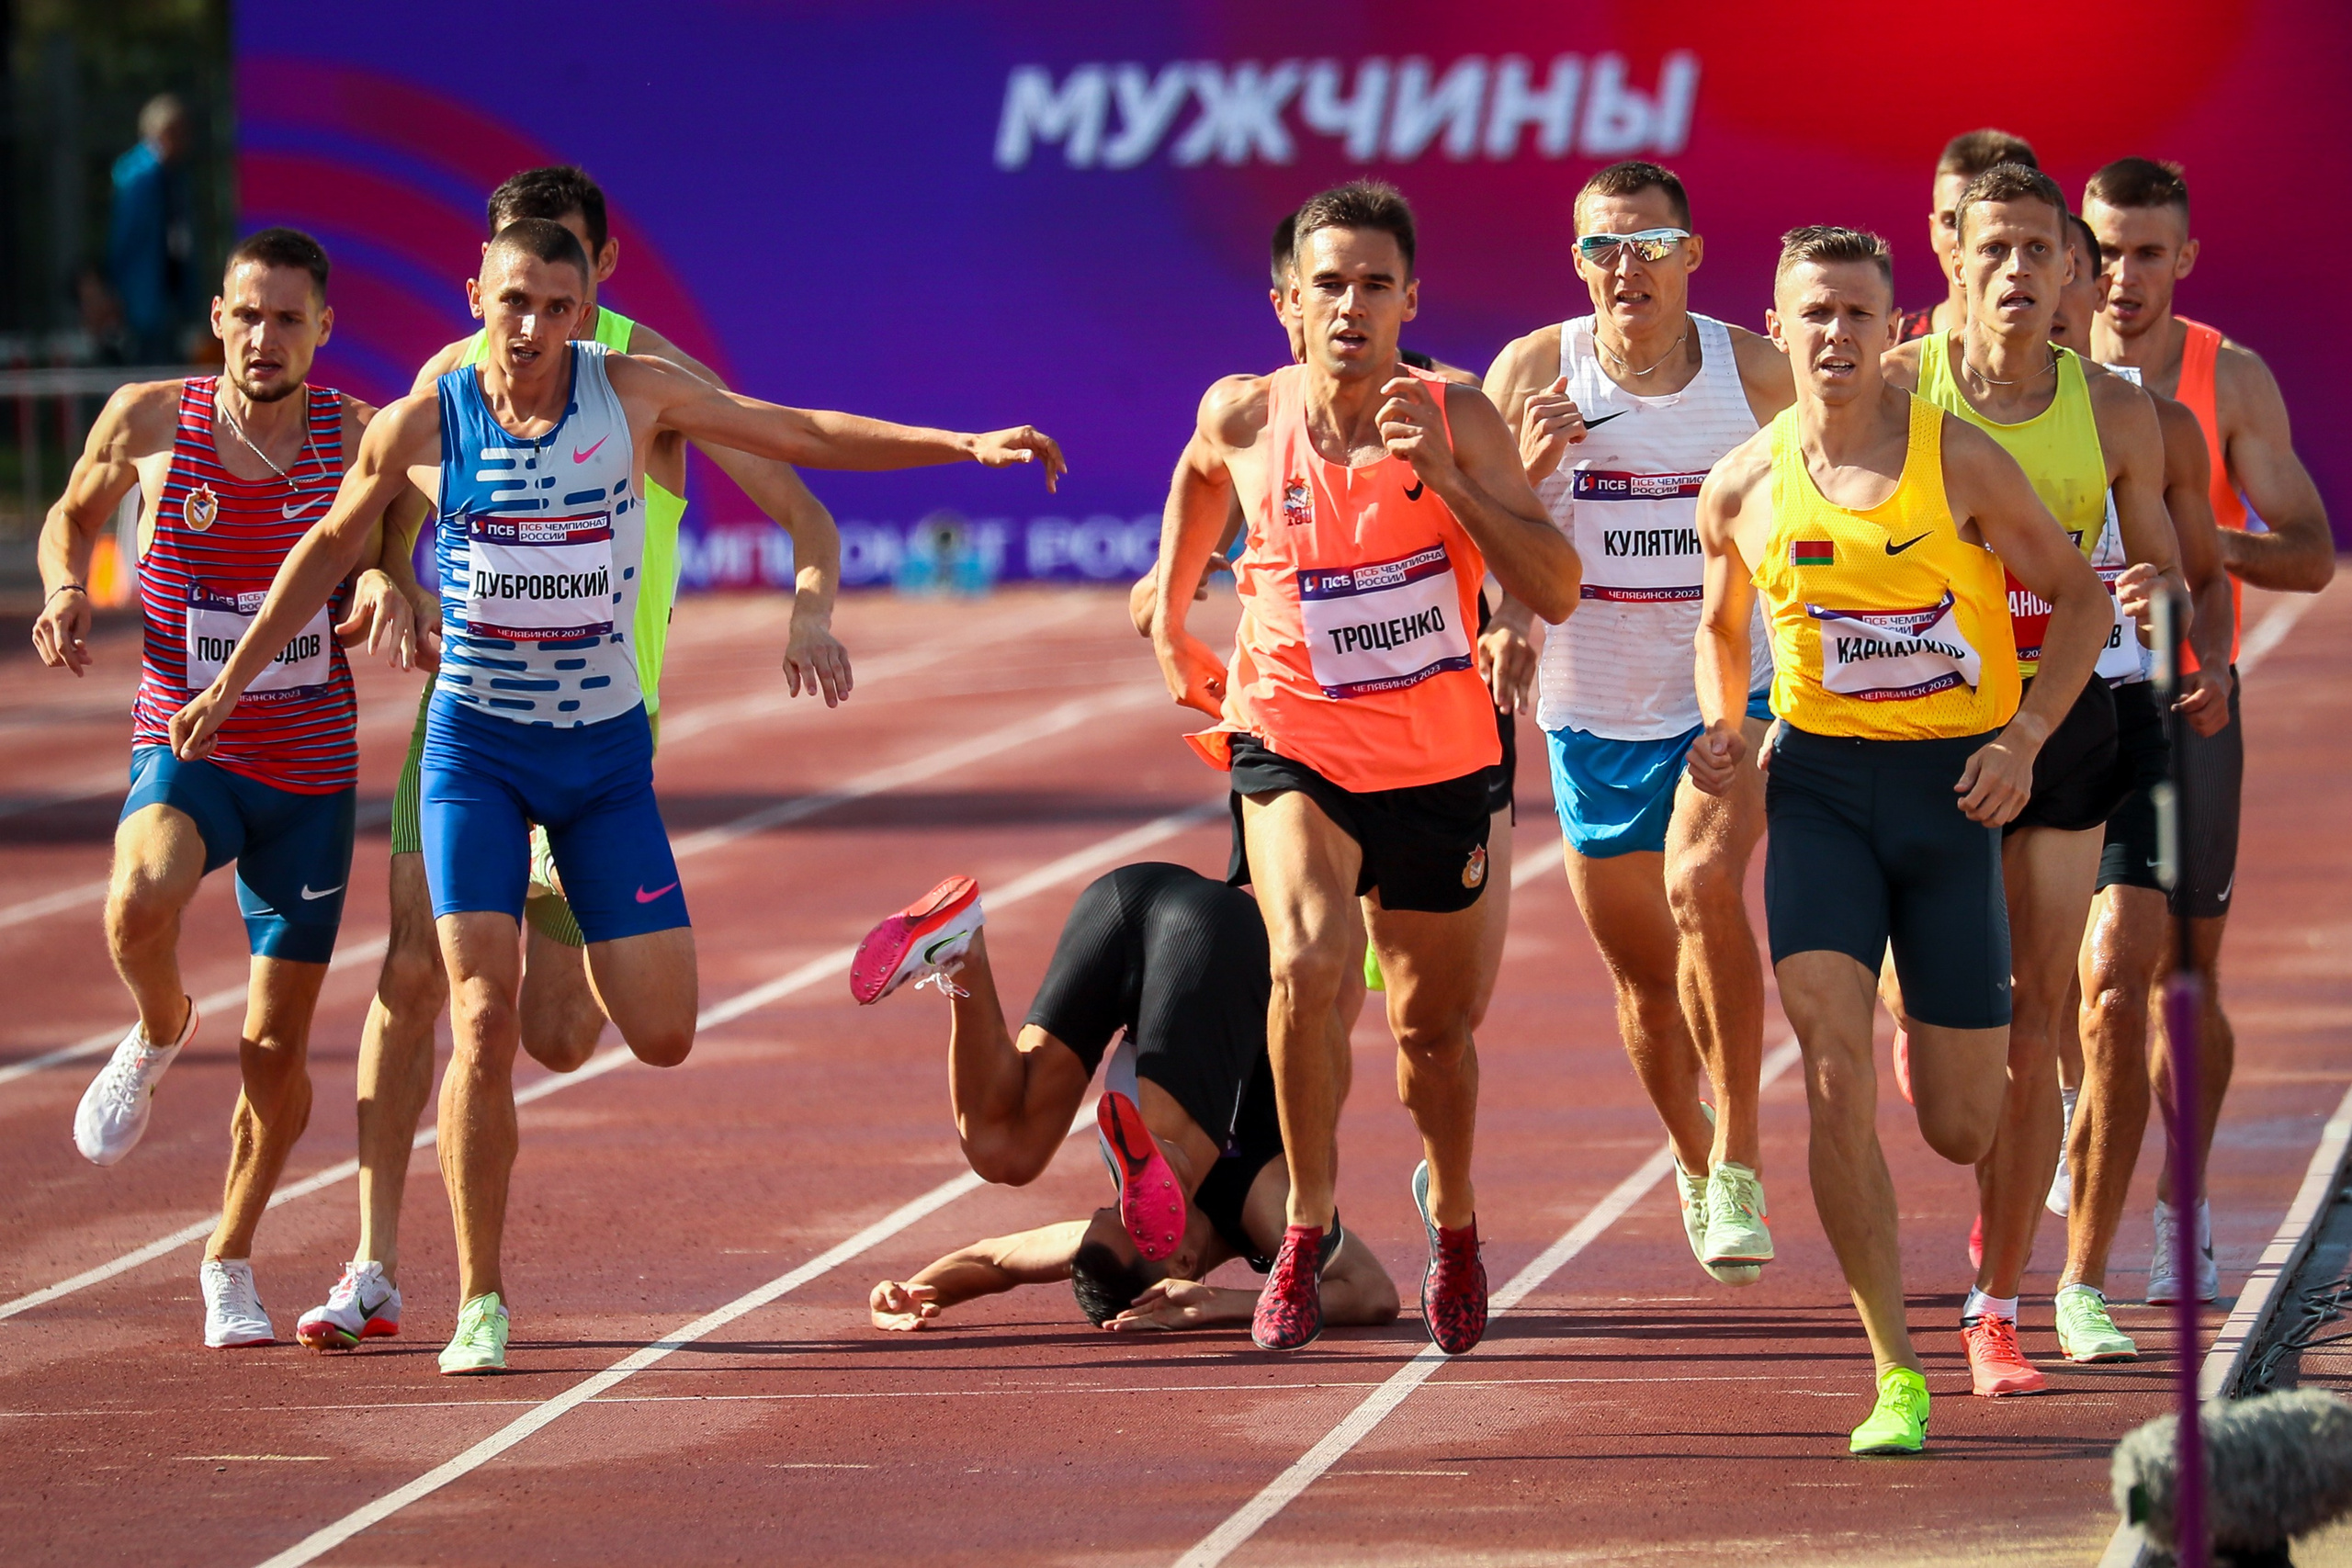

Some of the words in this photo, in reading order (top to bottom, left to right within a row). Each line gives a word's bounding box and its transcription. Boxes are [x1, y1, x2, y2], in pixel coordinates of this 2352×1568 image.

[994, 51, 1701, 170] МУЖЧИНЫ
[1598, 479, 1627, 491] ПСБ
[1632, 479, 1655, 487] ПСБ
[1657, 476, 1706, 486] ЧЕМПИО
[1632, 487, 1678, 495] РОССИИ
[488, 525, 515, 536] ПСБ
[545, 517, 606, 531] ЧЕМПИОНАТ
[1604, 528, 1702, 557] КУЛЯТИН
[1355, 568, 1379, 579] ПСБ
[1357, 573, 1405, 588] РОССИИ
[473, 565, 609, 600] ДУБРОВСКИЙ
[1322, 575, 1351, 589] ПСБ
[1609, 591, 1672, 599] ЧЕЛЯБИНСК
[1675, 590, 1701, 598] 2023
[497, 628, 559, 638] ЧЕЛЯБИНСК
[561, 628, 586, 637] 2023
[1328, 605, 1446, 655] ТРОЦЕНКО
[1352, 675, 1418, 693] ЧЕЛЯБИНСК
[1419, 664, 1441, 681] 2023
[278, 690, 300, 700] 2023
[1860, 686, 1926, 700] ЧЕЛЯБИНСК
[1928, 677, 1954, 692] 2023
